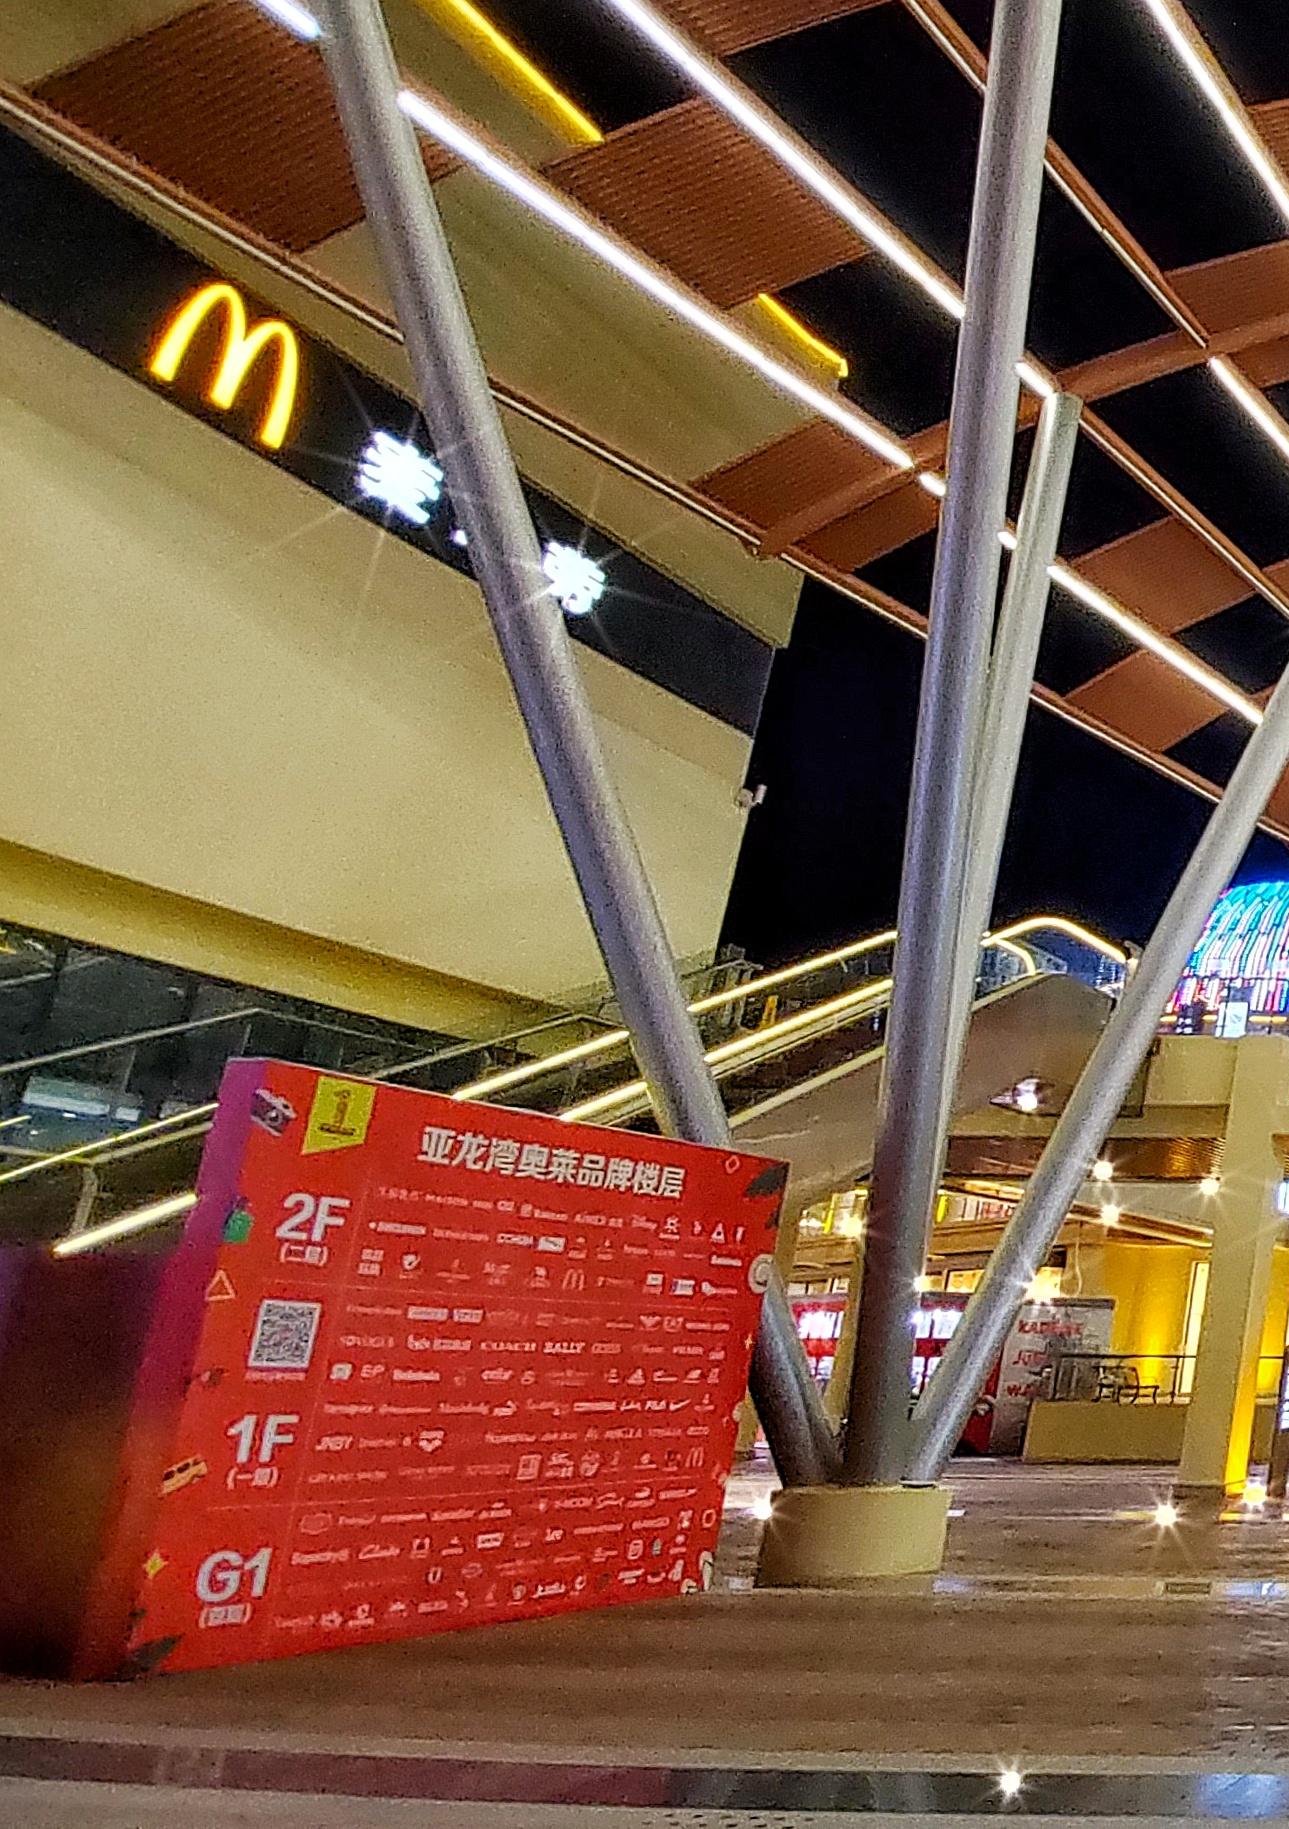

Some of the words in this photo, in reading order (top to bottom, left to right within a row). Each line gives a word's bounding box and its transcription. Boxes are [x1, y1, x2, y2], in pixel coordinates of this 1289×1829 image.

[417, 1125, 686, 1199] 亚龙湾奥莱品牌楼层
[275, 1192, 351, 1242] 2F
[226, 1414, 299, 1463] 1F
[196, 1547, 272, 1602] G1
